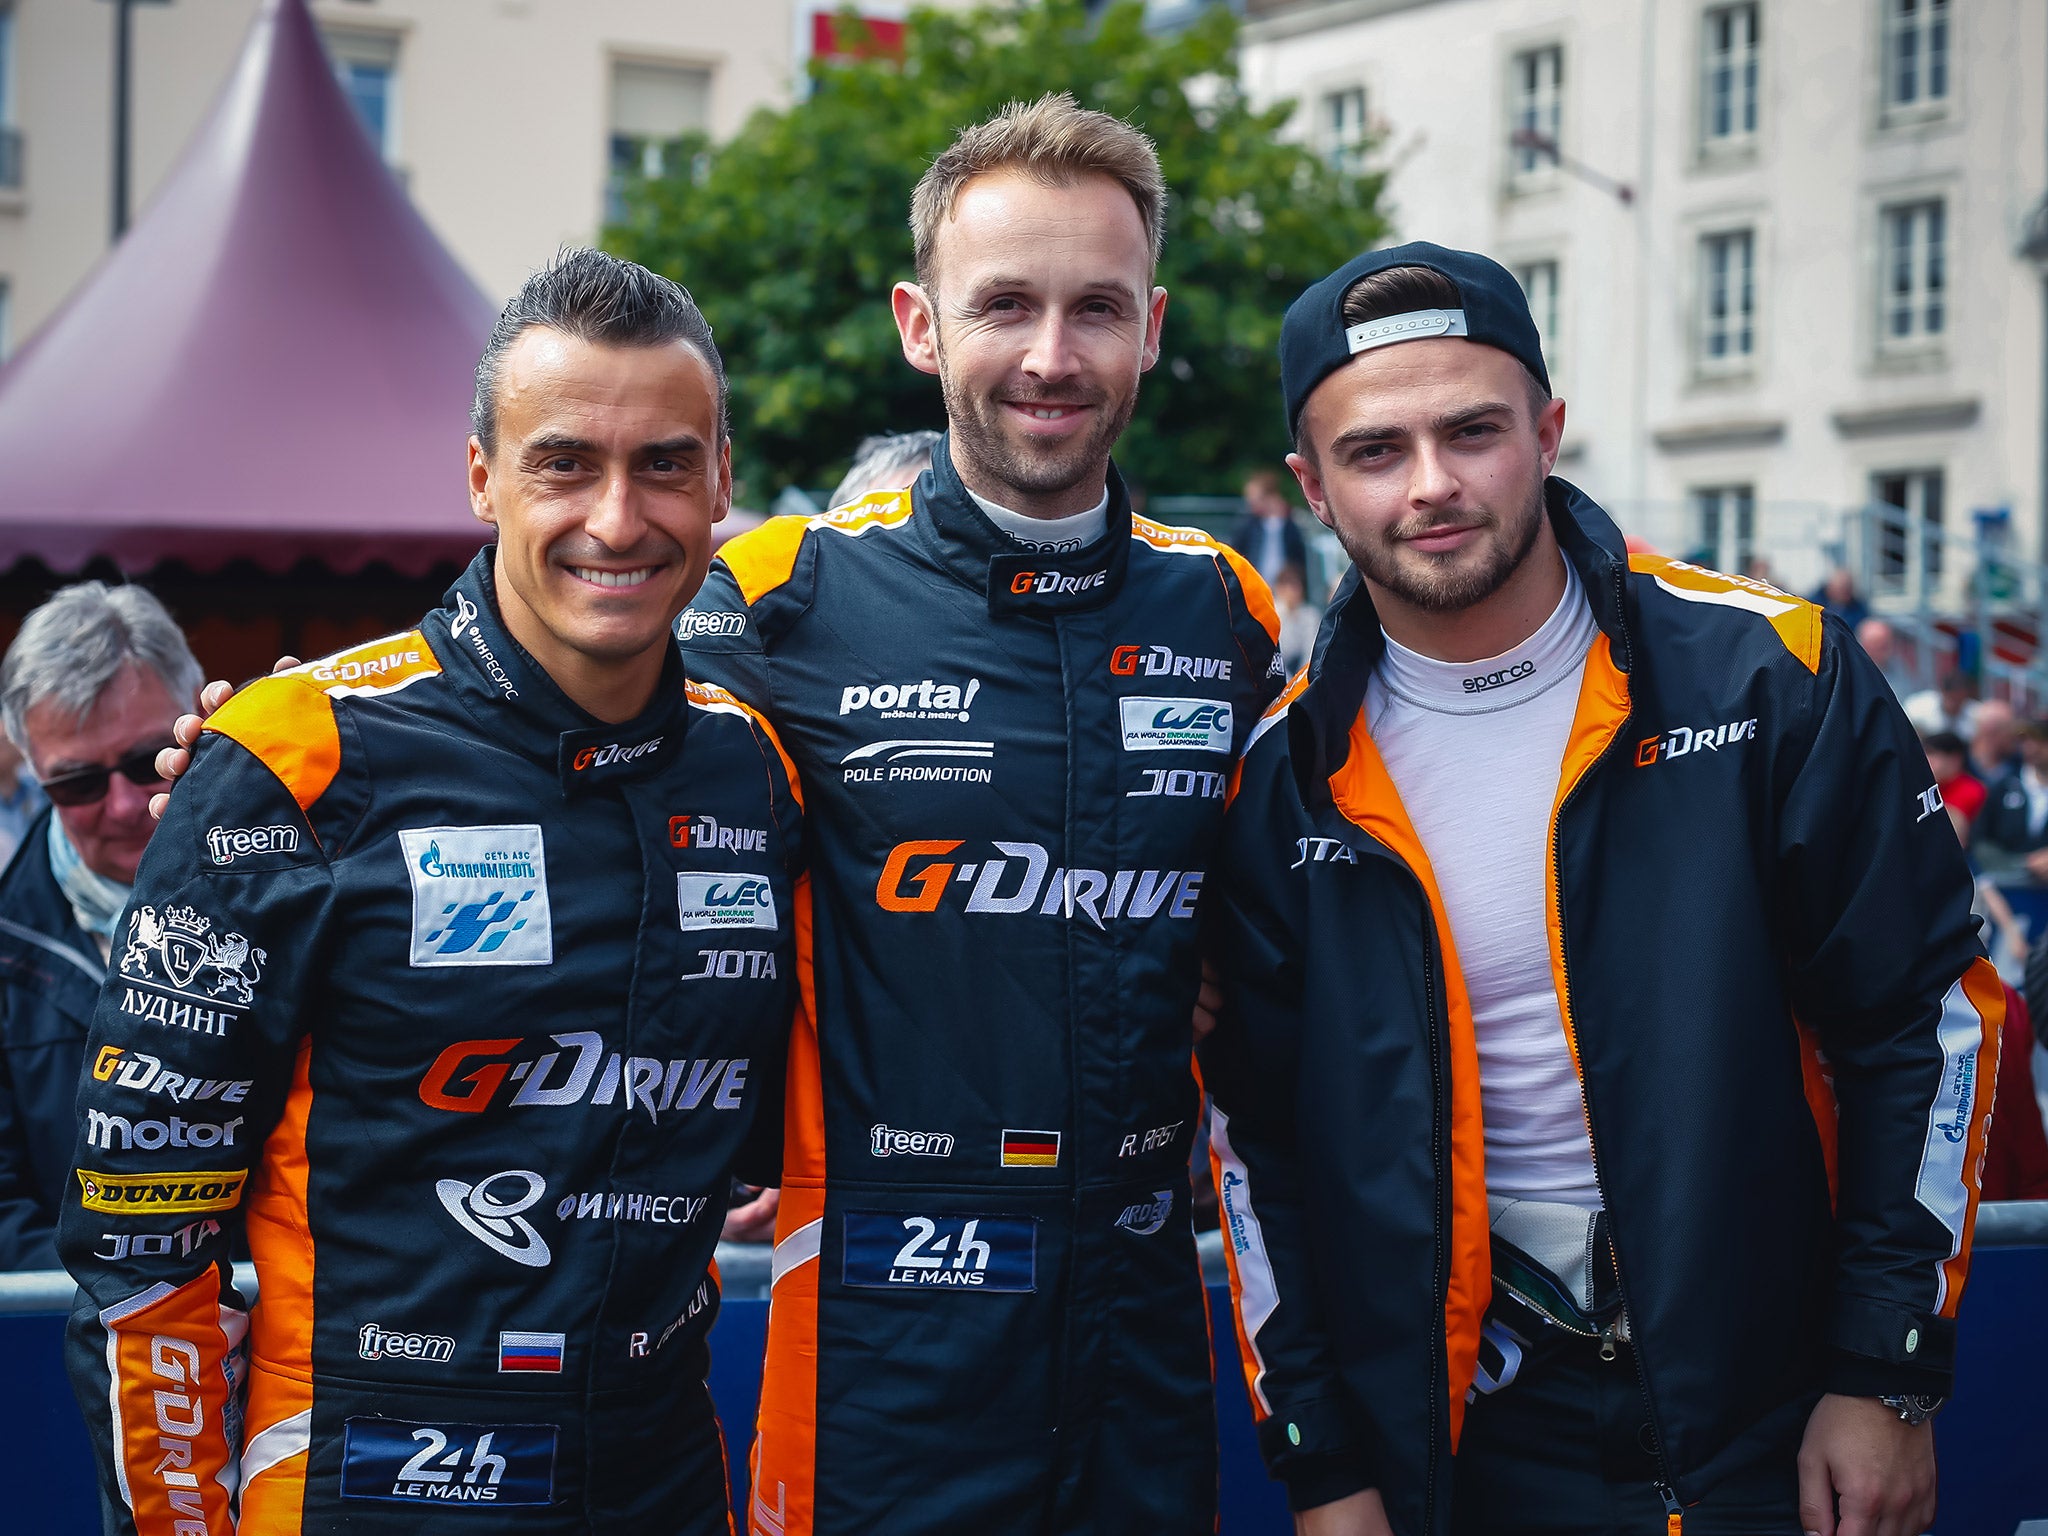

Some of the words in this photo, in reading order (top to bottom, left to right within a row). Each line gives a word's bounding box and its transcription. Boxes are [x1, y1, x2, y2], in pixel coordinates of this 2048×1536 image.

[1010, 569, 1107, 595] G-DRIVE
[677, 611, 746, 640] freem
[312, 651, 421, 681] G-DRIVE
[468, 626, 519, 700] ФИНРЕСУРС
[1110, 645, 1232, 682] G-DRIVE
[1462, 659, 1535, 693] sparco
[839, 678, 980, 722] porta!
[881, 710, 916, 719] möbel
[927, 711, 957, 720] mehr
[1152, 705, 1230, 732] WEC
[1167, 732, 1209, 740] ENDURANCE
[1635, 718, 1758, 768] G-DRIVE
[573, 736, 664, 771] G-DRIVE
[843, 768, 884, 783] POLE
[888, 767, 992, 783] PROMOTION
[1126, 769, 1226, 799] JOTA
[208, 827, 299, 862] freem
[669, 815, 767, 855] G-DRIVE
[443, 862, 535, 878] ГАЗПРОМНЕФТЬ
[484, 851, 509, 860] СЕТЬ
[512, 851, 530, 860] АЗС
[704, 881, 770, 907] WEC
[876, 840, 1205, 931] G-DRIVE
[681, 949, 777, 980] JOTA
[120, 988, 238, 1037] ЛУДИНГ
[92, 1045, 254, 1103] G-DRIVE
[418, 1031, 750, 1125] G-DRIVE
[87, 1108, 244, 1150] motor
[870, 1123, 955, 1157] freem
[1118, 1133, 1138, 1157] R.
[101, 1179, 243, 1202] DUNLOP
[94, 1218, 222, 1260] JOTA
[893, 1217, 990, 1270] 24h
[888, 1269, 915, 1283] LE
[919, 1270, 984, 1285] MANS
[360, 1324, 455, 1362] freem
[629, 1332, 651, 1358] R.
[398, 1428, 507, 1484] 24h
[392, 1483, 424, 1497] LE
[426, 1484, 498, 1500] MANS
